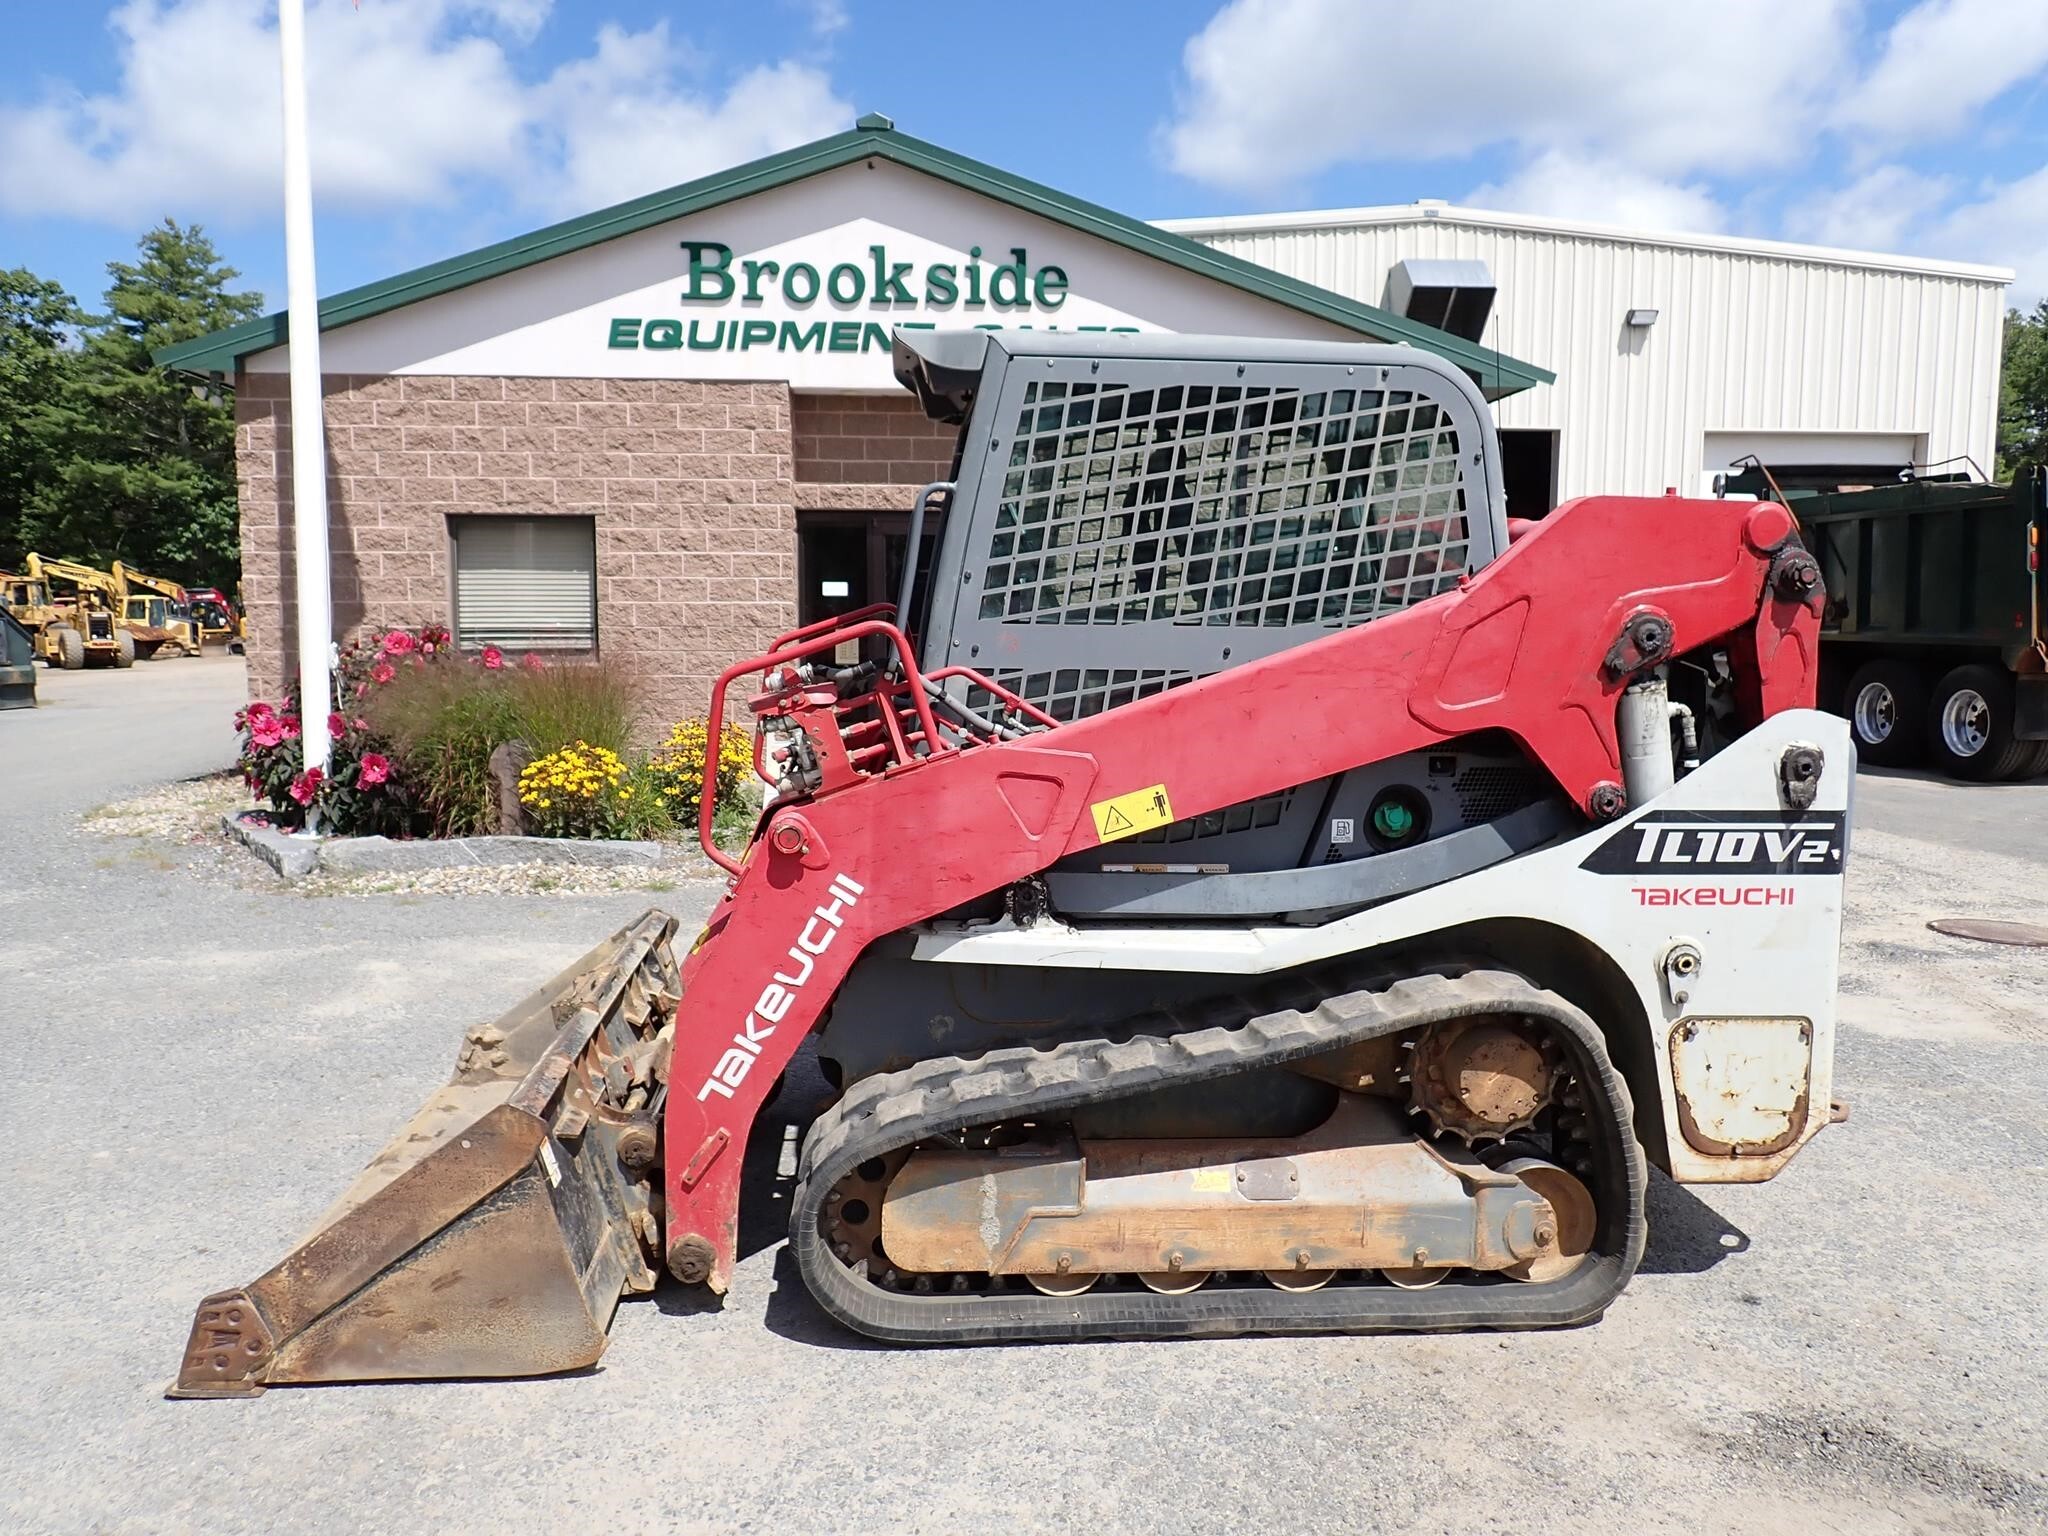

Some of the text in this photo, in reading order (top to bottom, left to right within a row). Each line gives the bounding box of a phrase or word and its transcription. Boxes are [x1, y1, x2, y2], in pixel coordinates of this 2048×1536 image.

[680, 241, 1069, 307] Brookside
[608, 318, 935, 353] EQUIPMEN
[1633, 822, 1836, 863] TL10V2
[1631, 887, 1795, 906] TAKEUCHI
[697, 872, 865, 1102] TAKEUCHI
